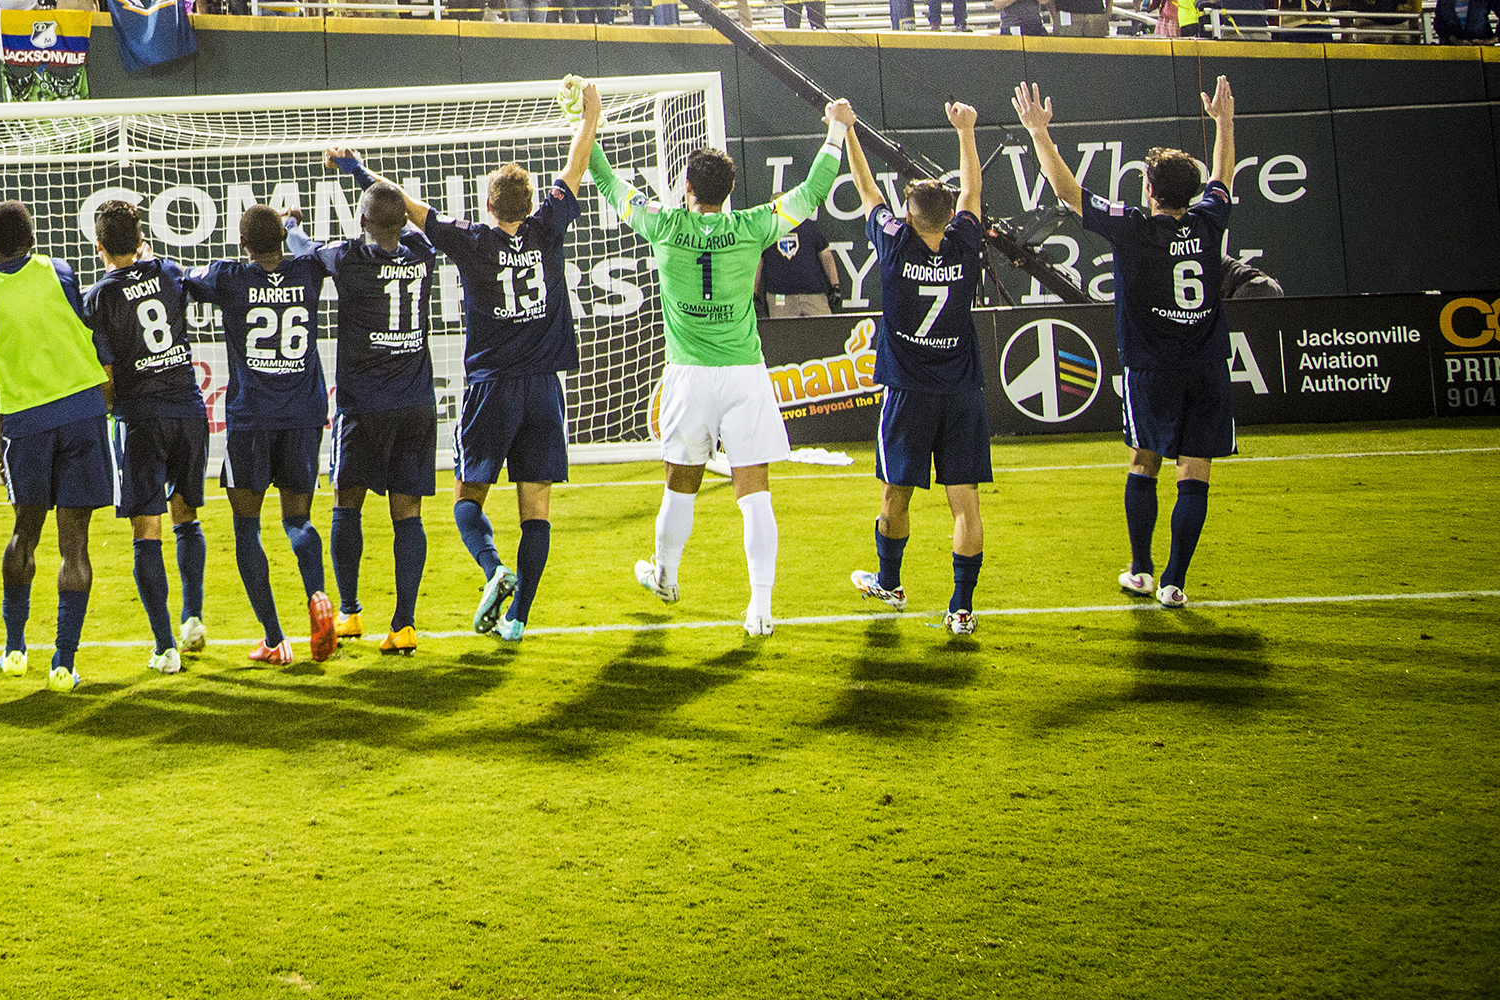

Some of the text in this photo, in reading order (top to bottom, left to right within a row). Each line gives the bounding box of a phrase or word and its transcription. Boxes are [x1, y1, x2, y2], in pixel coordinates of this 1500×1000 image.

[4, 50, 86, 64] JACKSONVILLE
[674, 231, 736, 250] GALLARDO
[1169, 238, 1203, 256] ORTIZ
[498, 249, 543, 267] BAHNER
[376, 261, 428, 279] JOHNSON
[696, 251, 713, 301] 1
[902, 261, 964, 282] RODRIGUEZ
[122, 276, 162, 301] BOCHY
[248, 286, 305, 304] BARRETT
[496, 261, 548, 314] 13
[1173, 260, 1205, 310] 6
[383, 278, 423, 331] 11
[677, 301, 735, 313] COMMUNITY
[914, 285, 949, 337] 7
[136, 298, 173, 354] 8
[709, 311, 734, 321] FIRST
[246, 305, 310, 359] 26
[1296, 325, 1421, 347] Jacksonville
[164, 353, 188, 367] FIRST
[1299, 350, 1379, 370] Aviation
[1300, 373, 1392, 394] Authority
[809, 397, 855, 416] Beyond
[855, 392, 874, 408] the
